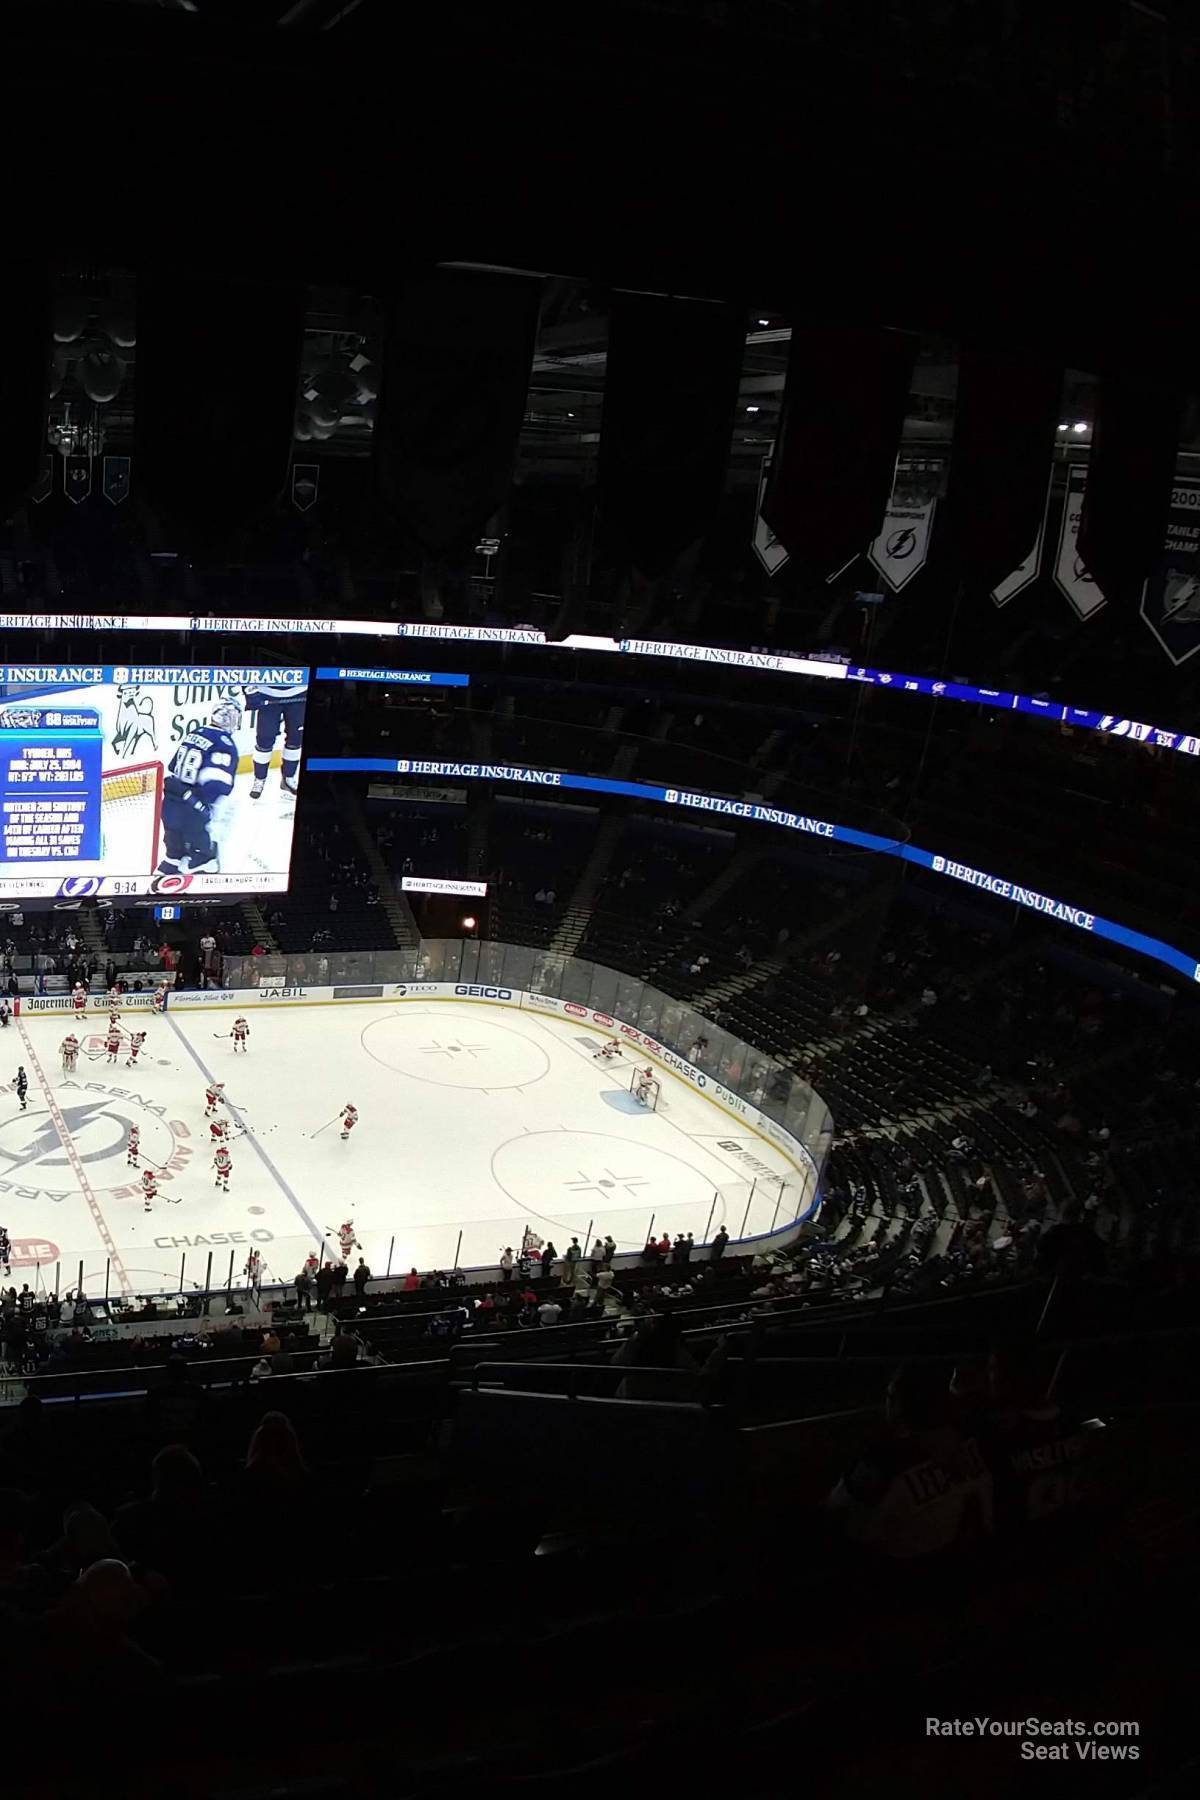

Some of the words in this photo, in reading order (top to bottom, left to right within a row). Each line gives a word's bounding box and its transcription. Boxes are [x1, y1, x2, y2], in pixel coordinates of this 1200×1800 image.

[1167, 524, 1200, 538] TANLE
[55, 616, 128, 629] INSURANCE
[204, 618, 263, 632] HERITAGE
[266, 619, 337, 632] INSURANCE
[411, 625, 474, 640] HERITAGE
[478, 628, 546, 644] INSURANC
[634, 640, 701, 660] HERITAGE
[704, 648, 784, 670] INSURANCE
[8, 667, 103, 683] INSURANCE
[131, 668, 210, 684] HERITAGE
[213, 669, 303, 684] INSURANCE
[346, 669, 385, 680] HERITAGE
[386, 671, 431, 682] INSURANCE
[411, 761, 479, 778] HERITAGE
[481, 765, 561, 786] INSURANCE
[680, 792, 752, 817] HERITAGE
[754, 806, 834, 838] INSURANCE
[113, 881, 137, 894] 9:34
[946, 861, 1010, 896] HERITAGE
[1010, 885, 1095, 931] INSURANCE
[259, 987, 307, 998] JABIL
[454, 984, 512, 1001] GEICO
[619, 1024, 642, 1040] DEX
[643, 1037, 662, 1054] DEX
[663, 1052, 697, 1081] CHASE
[59, 1079, 169, 1117] ARENA
[714, 1085, 747, 1115] Publix
[154, 1231, 248, 1249] CHASE
